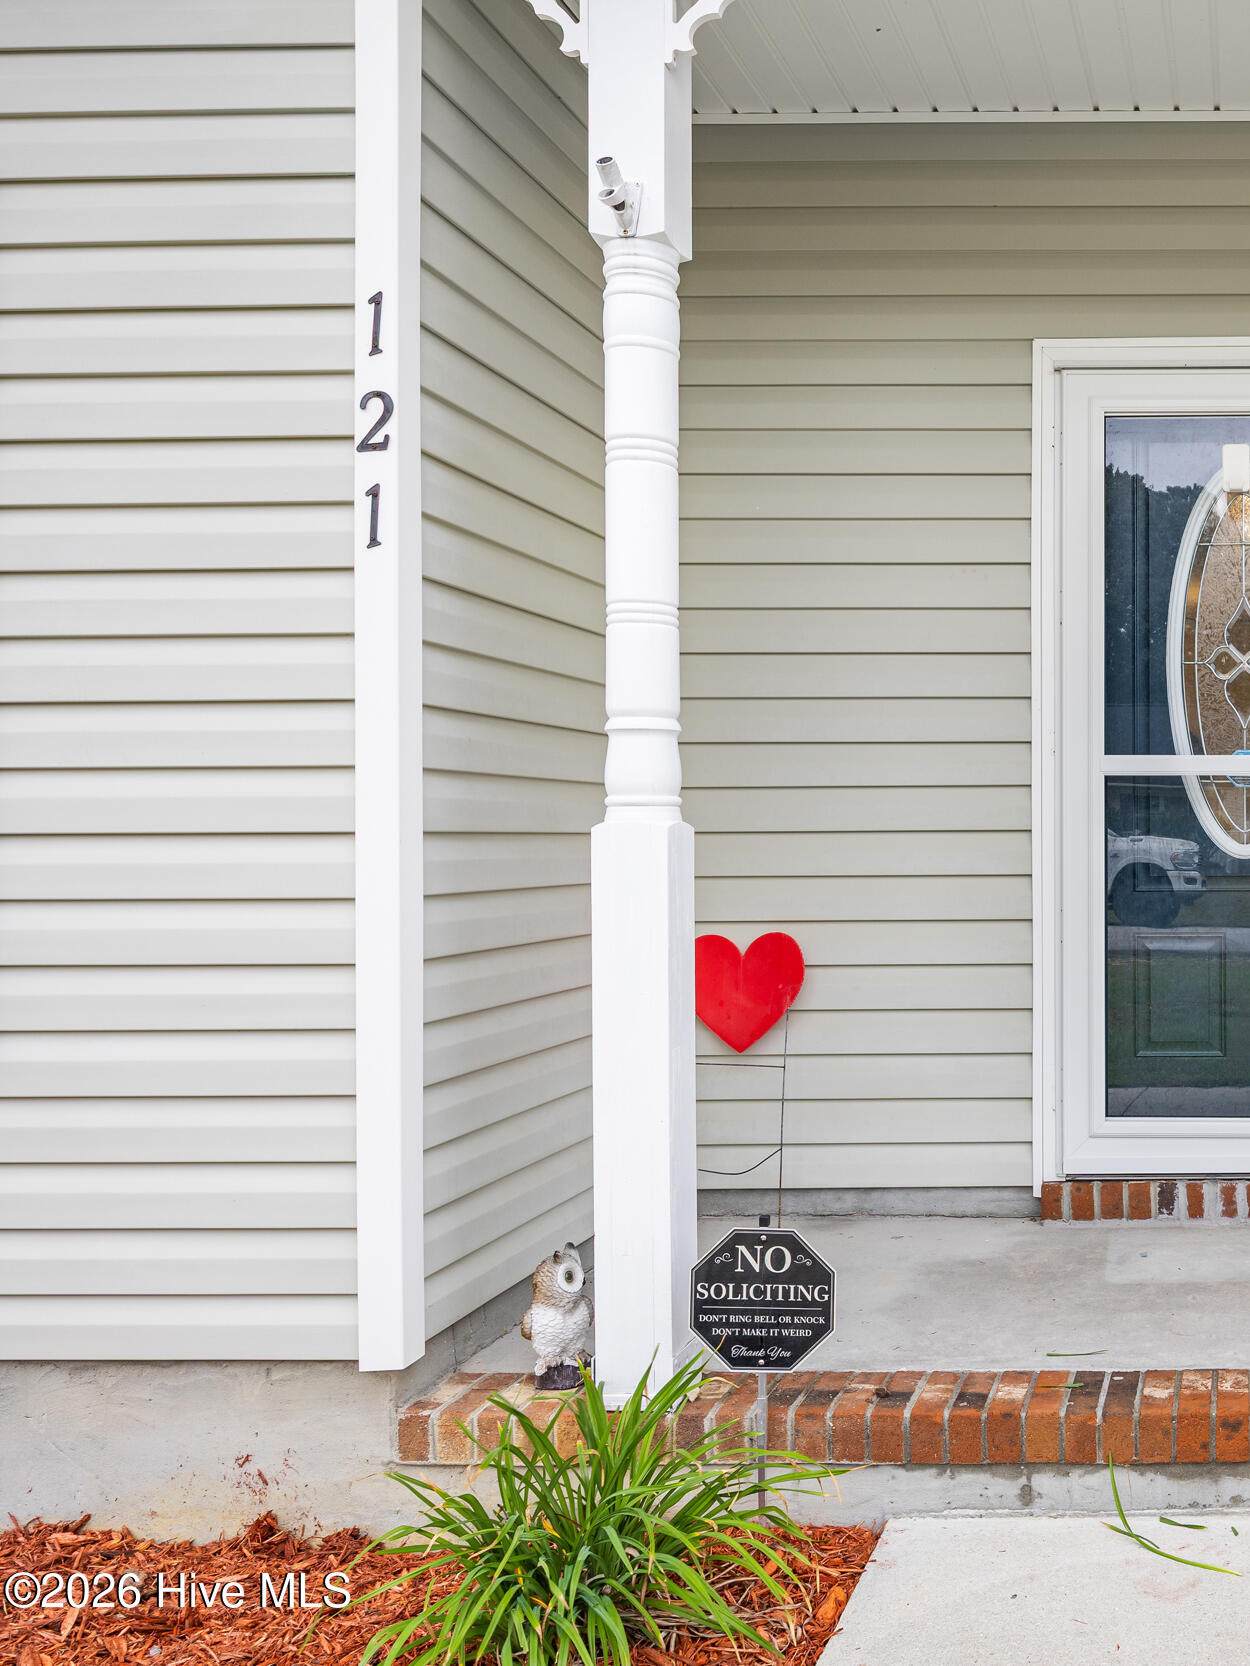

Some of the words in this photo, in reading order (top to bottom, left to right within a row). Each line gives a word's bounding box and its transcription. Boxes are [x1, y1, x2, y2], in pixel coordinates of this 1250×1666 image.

[356, 291, 394, 549] 121
[734, 1245, 792, 1273] NO
[696, 1282, 830, 1302] SOLICITING
[699, 1314, 728, 1323] DON'T
[729, 1315, 752, 1323] RING
[754, 1315, 777, 1324] BELL
[778, 1316, 792, 1324] OR
[794, 1316, 825, 1324] KNOCK
[712, 1328, 740, 1336] DON'T
[742, 1328, 768, 1336] MAKE
[769, 1328, 780, 1336] IT
[781, 1329, 812, 1337] WEIRD
[731, 1344, 766, 1358] Thank
[767, 1346, 792, 1360] You
